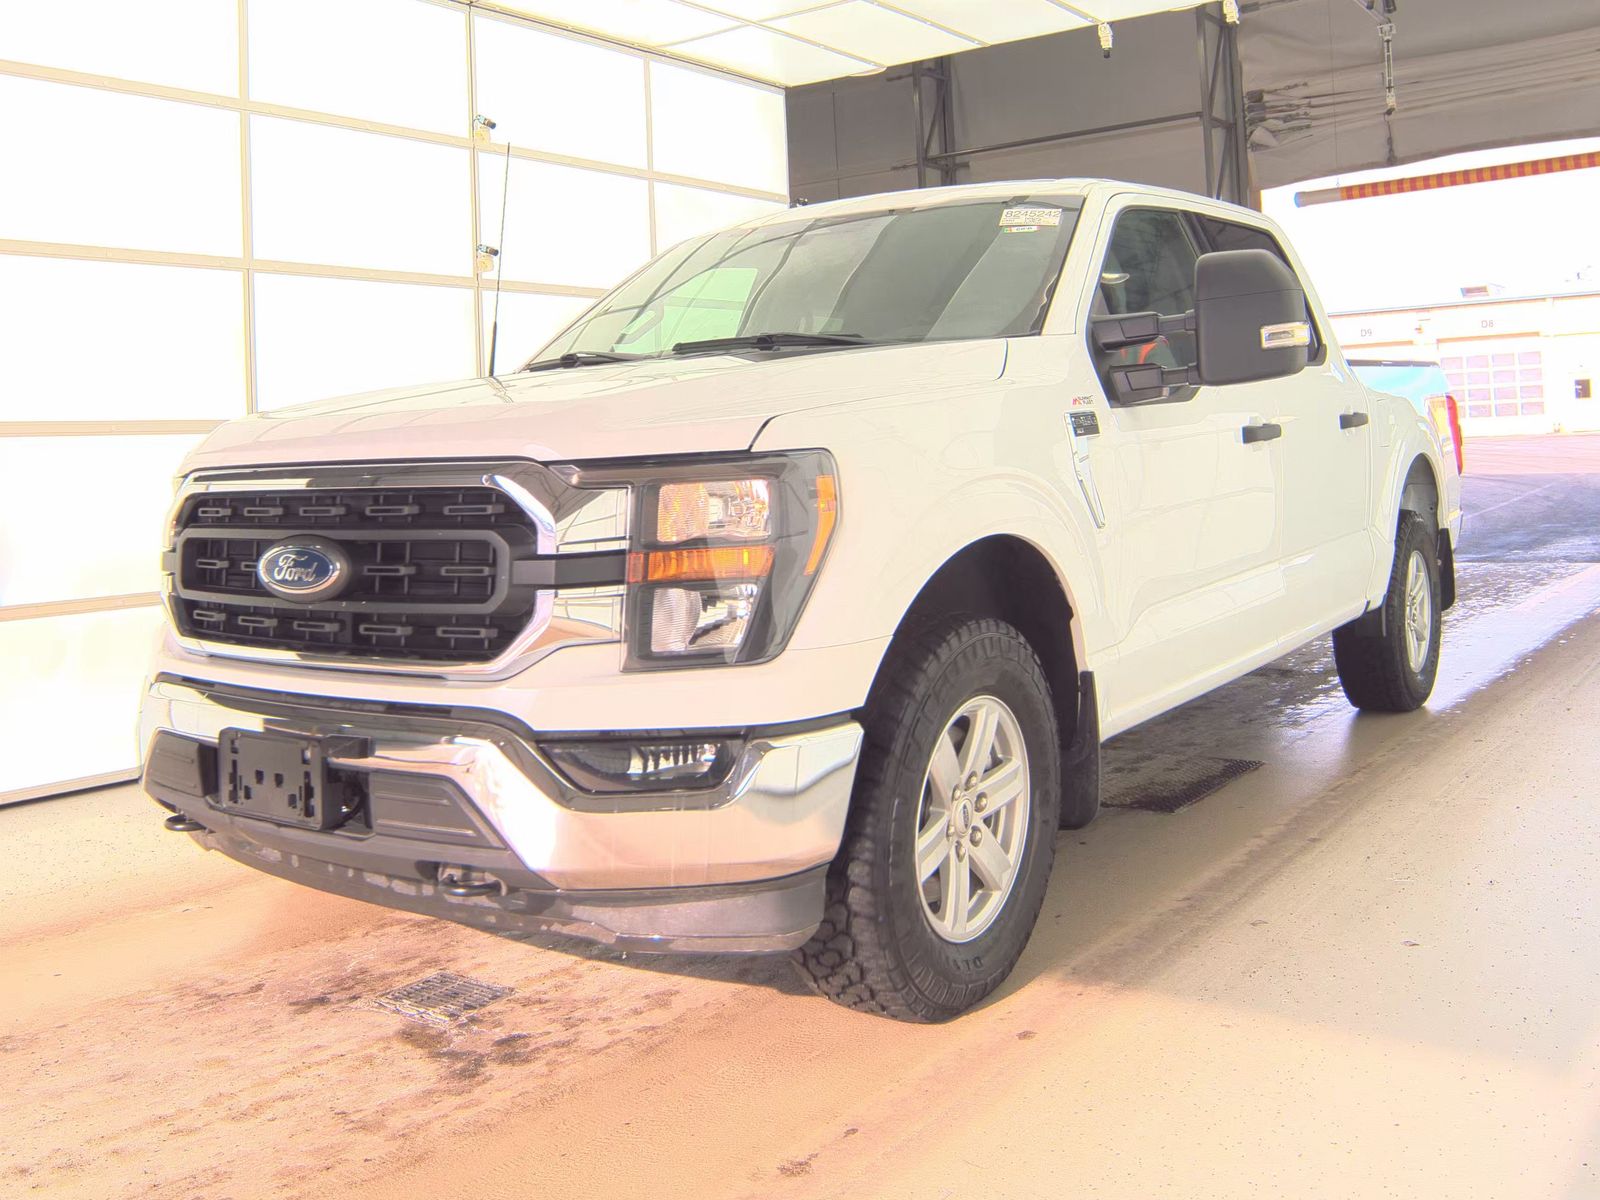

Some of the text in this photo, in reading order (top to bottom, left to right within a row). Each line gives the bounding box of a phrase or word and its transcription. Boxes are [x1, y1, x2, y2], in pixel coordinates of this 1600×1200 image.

[1481, 320, 1494, 328] D8
[1360, 328, 1373, 337] D9
[274, 553, 318, 582] Ford
